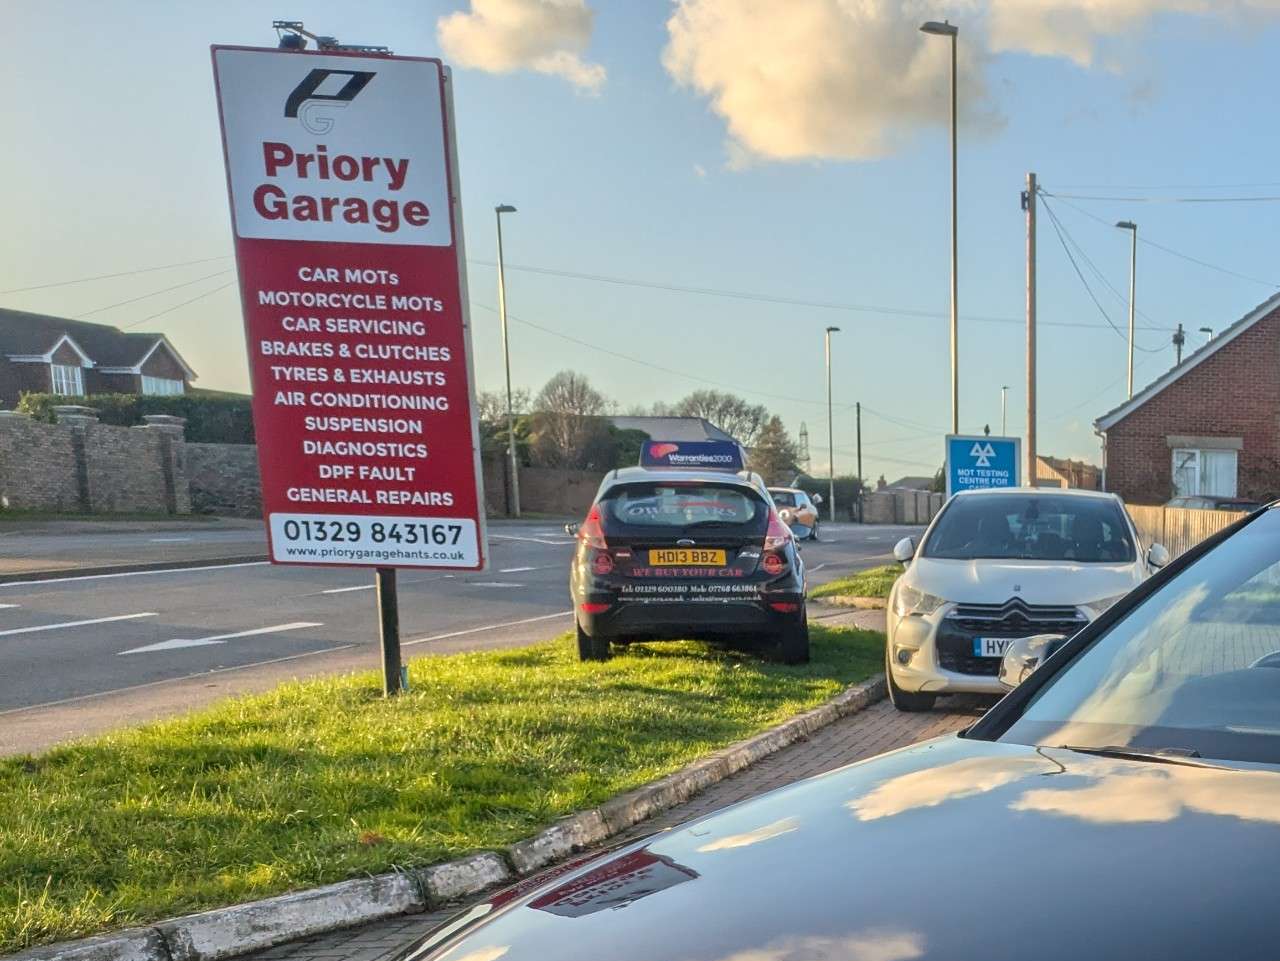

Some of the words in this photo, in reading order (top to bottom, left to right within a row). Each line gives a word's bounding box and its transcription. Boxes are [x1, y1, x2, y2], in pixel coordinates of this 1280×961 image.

[262, 142, 409, 191] Priory
[253, 184, 430, 232] Garage
[299, 267, 339, 283] CAR
[345, 269, 399, 285] MOTs
[259, 291, 386, 310] MOTORCYCLE
[392, 296, 443, 312] MOTs
[282, 317, 320, 332] CAR
[326, 319, 425, 336] SERVICING
[261, 341, 334, 357] BRAKES
[339, 343, 350, 358] &
[356, 344, 450, 361] CLUTCHES
[271, 366, 328, 382] TYRES
[334, 368, 345, 382] &
[351, 369, 446, 386] EXHAUSTS
[274, 391, 305, 406] AIR
[310, 392, 448, 411] CONDITIONING
[305, 417, 422, 434] SUSPENSION
[304, 441, 428, 458] DIAGNOSTICS
[320, 465, 354, 479] DPF
[359, 466, 416, 481] FAULT
[958, 469, 974, 477] MOT
[976, 469, 1009, 478] TESTING
[959, 477, 990, 485] CENTRE
[992, 478, 1008, 486] FOR
[287, 488, 372, 504] GENERAL
[376, 490, 453, 506] REPAIRS
[284, 520, 361, 542] 01329
[371, 522, 462, 545] 843167
[287, 547, 464, 561] www.priorygaragehants.co.uk
[657, 551, 688, 563] HD13
[691, 551, 718, 563] BBZ
[718, 569, 744, 577] CAR
